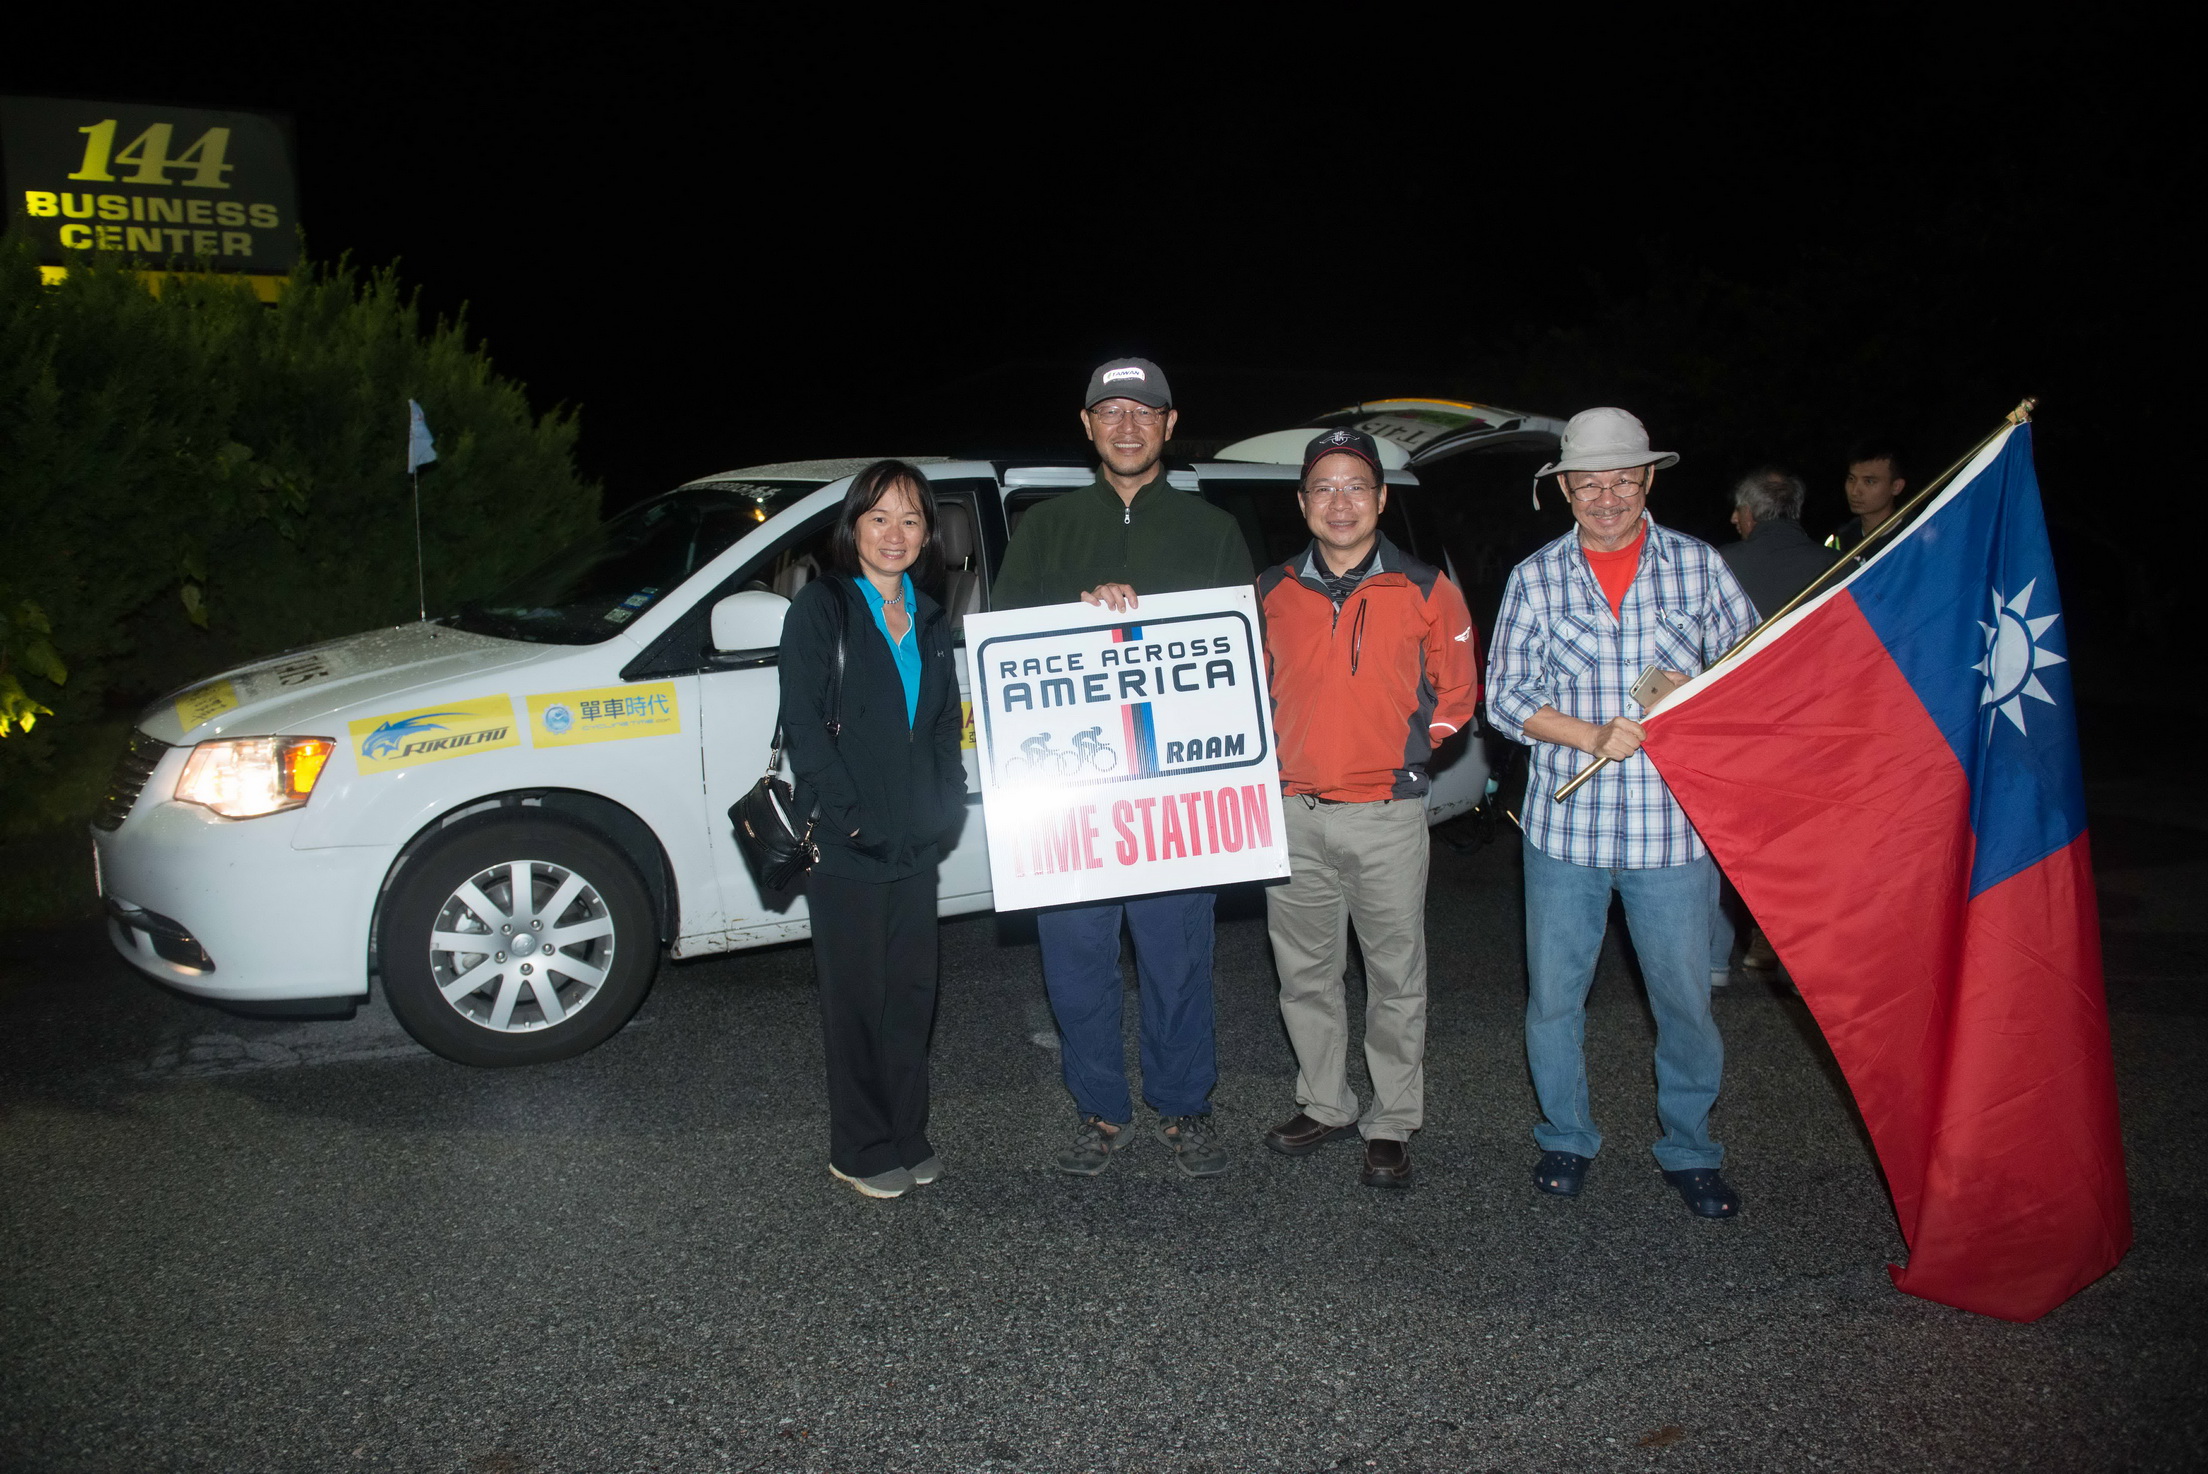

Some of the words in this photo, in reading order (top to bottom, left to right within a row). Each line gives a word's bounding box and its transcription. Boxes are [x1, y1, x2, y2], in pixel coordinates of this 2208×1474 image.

[67, 119, 234, 189] 144
[25, 190, 279, 229] BUSINESS
[59, 223, 253, 257] CENTER
[1000, 653, 1084, 679] RACE
[1101, 636, 1232, 667] ACROSS
[1003, 659, 1236, 712] AMERICA
[580, 693, 670, 721] 單車時代
[1166, 733, 1246, 764] RAAM
[1112, 783, 1273, 866] STATION
